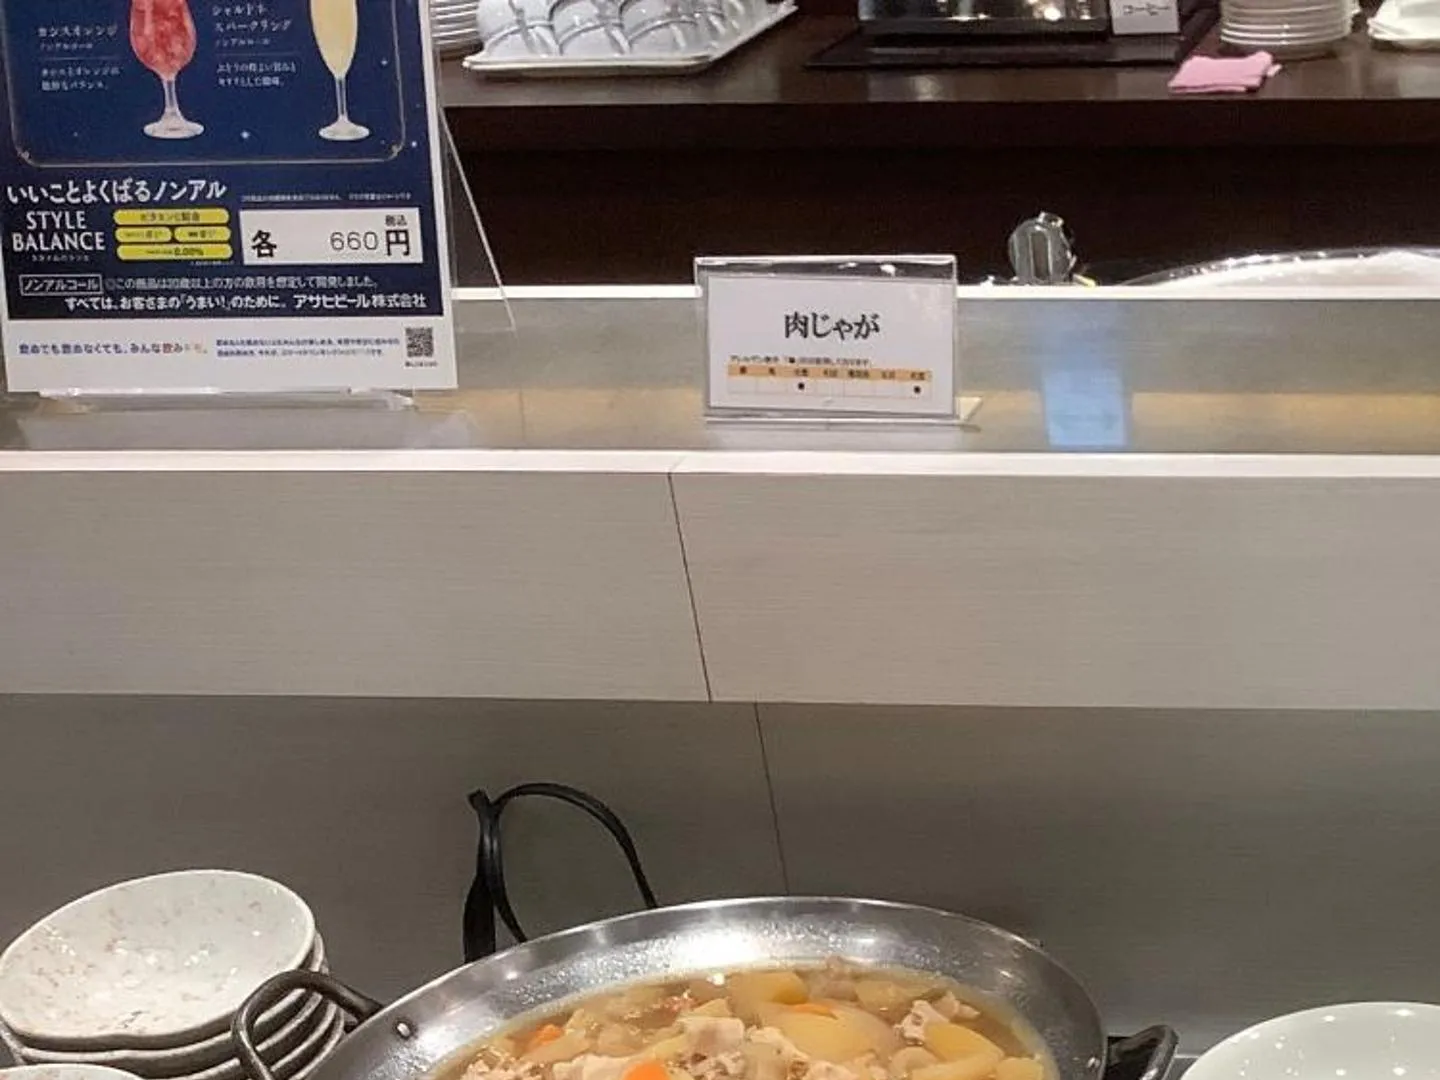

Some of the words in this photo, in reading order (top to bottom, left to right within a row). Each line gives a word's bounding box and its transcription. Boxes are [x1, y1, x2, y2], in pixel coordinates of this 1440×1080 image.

[7, 177, 227, 204] いいことよくばるノンアル
[26, 210, 87, 230] STYLE
[12, 231, 106, 252] BALANCE
[252, 230, 277, 258] 各
[330, 231, 379, 251] 660
[385, 229, 410, 257] 円
[24, 278, 99, 292] ノンアルコール
[293, 293, 427, 309] アサヒビール株式会社
[784, 311, 880, 340] 肉じゃが
